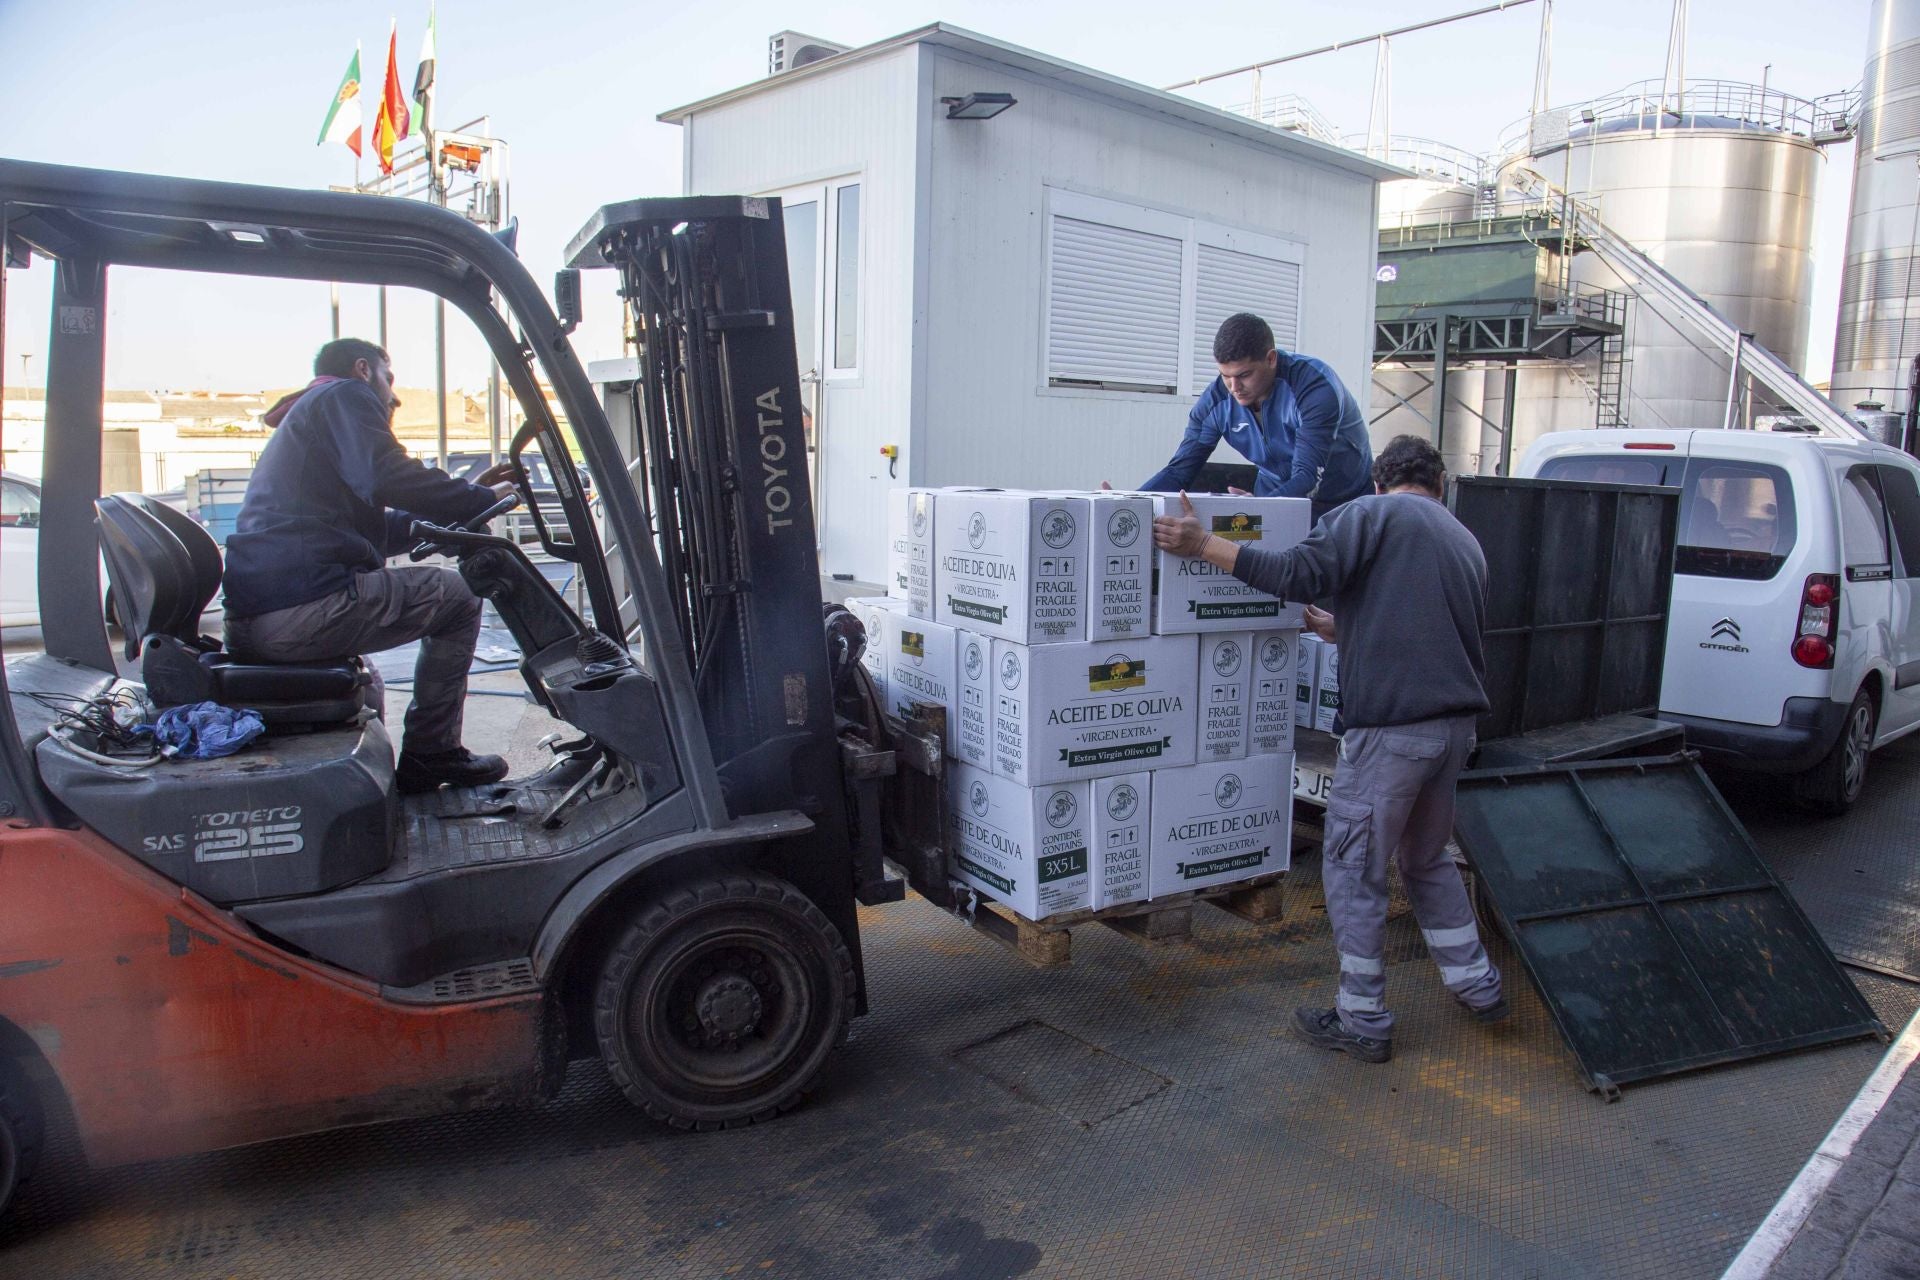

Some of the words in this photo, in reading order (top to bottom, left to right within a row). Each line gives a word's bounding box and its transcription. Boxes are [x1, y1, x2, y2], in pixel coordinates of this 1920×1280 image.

[756, 386, 793, 536] TOYOTA
[943, 556, 970, 574] ACEITE
[972, 560, 985, 576] DE
[987, 562, 1016, 581] OLIVA
[1178, 560, 1232, 576] ACEI
[957, 583, 976, 596] VIRGEN
[977, 587, 996, 600] EXTRA
[1036, 581, 1077, 593] FRAGIL
[1103, 579, 1142, 592] FRAGIL
[1207, 586, 1240, 596] VIRGEN
[1035, 595, 1077, 606] FRAGILE
[1103, 592, 1142, 604] FRAGILE
[1035, 607, 1076, 618] CUIDADO
[1103, 605, 1141, 616] CUIDADO
[1201, 607, 1221, 616] Extra
[1222, 606, 1244, 616] Virgin
[1245, 606, 1263, 614] Olive
[1264, 605, 1275, 613] Oil
[1034, 620, 1076, 629] EMBALAGEM
[1102, 618, 1142, 627] EMBALAGEM
[892, 666, 913, 687] ACEITE
[914, 673, 924, 691] DE
[925, 680, 947, 701] OLIVA
[1047, 704, 1107, 725] ACEITE
[1111, 701, 1134, 719] DE
[1137, 696, 1183, 716] OLIVA
[1208, 705, 1241, 718] FRAGIL
[1256, 700, 1289, 712] FRAGIL
[963, 706, 984, 724] FRAGIL
[1207, 717, 1241, 730] FRAGILE
[1255, 711, 1289, 723] FRAGILE
[963, 719, 984, 736] FRAGILE
[997, 717, 1021, 736] FRAGIL
[1081, 730, 1119, 743] VIRGEN
[1121, 725, 1152, 738] EXTRA
[1206, 729, 1240, 740] CUIDADO
[1255, 722, 1288, 733] CUIDADO
[997, 731, 1021, 748] FRAGILE
[997, 743, 1021, 759] CUIDADO
[1074, 755, 1097, 763] Extra
[1098, 750, 1122, 760] Virgin
[1124, 748, 1144, 757] Olive
[1146, 745, 1157, 754] Oil
[1167, 820, 1218, 842] ACEITE
[1221, 816, 1241, 834] DE
[1243, 809, 1281, 829] OLIVA
[143, 833, 186, 851] SAS
[194, 822, 304, 863] 25
[951, 812, 975, 837] CEITE
[976, 825, 989, 845] DE
[991, 833, 1023, 861] OLIVA
[1042, 829, 1082, 845] CONTIENE
[1042, 838, 1083, 855] CONTAINS
[1195, 843, 1228, 857] VIRGEN
[1228, 837, 1256, 851] EXTRA
[983, 852, 1003, 871] EXTRA
[1104, 847, 1141, 864] FRAGIL
[1104, 859, 1141, 876] FRAGILE
[1188, 866, 1208, 876] Extra
[1209, 861, 1230, 871] Virgin
[1231, 858, 1249, 868] Olive
[1249, 855, 1259, 864] Oil
[1104, 871, 1141, 886] CUIDADO
